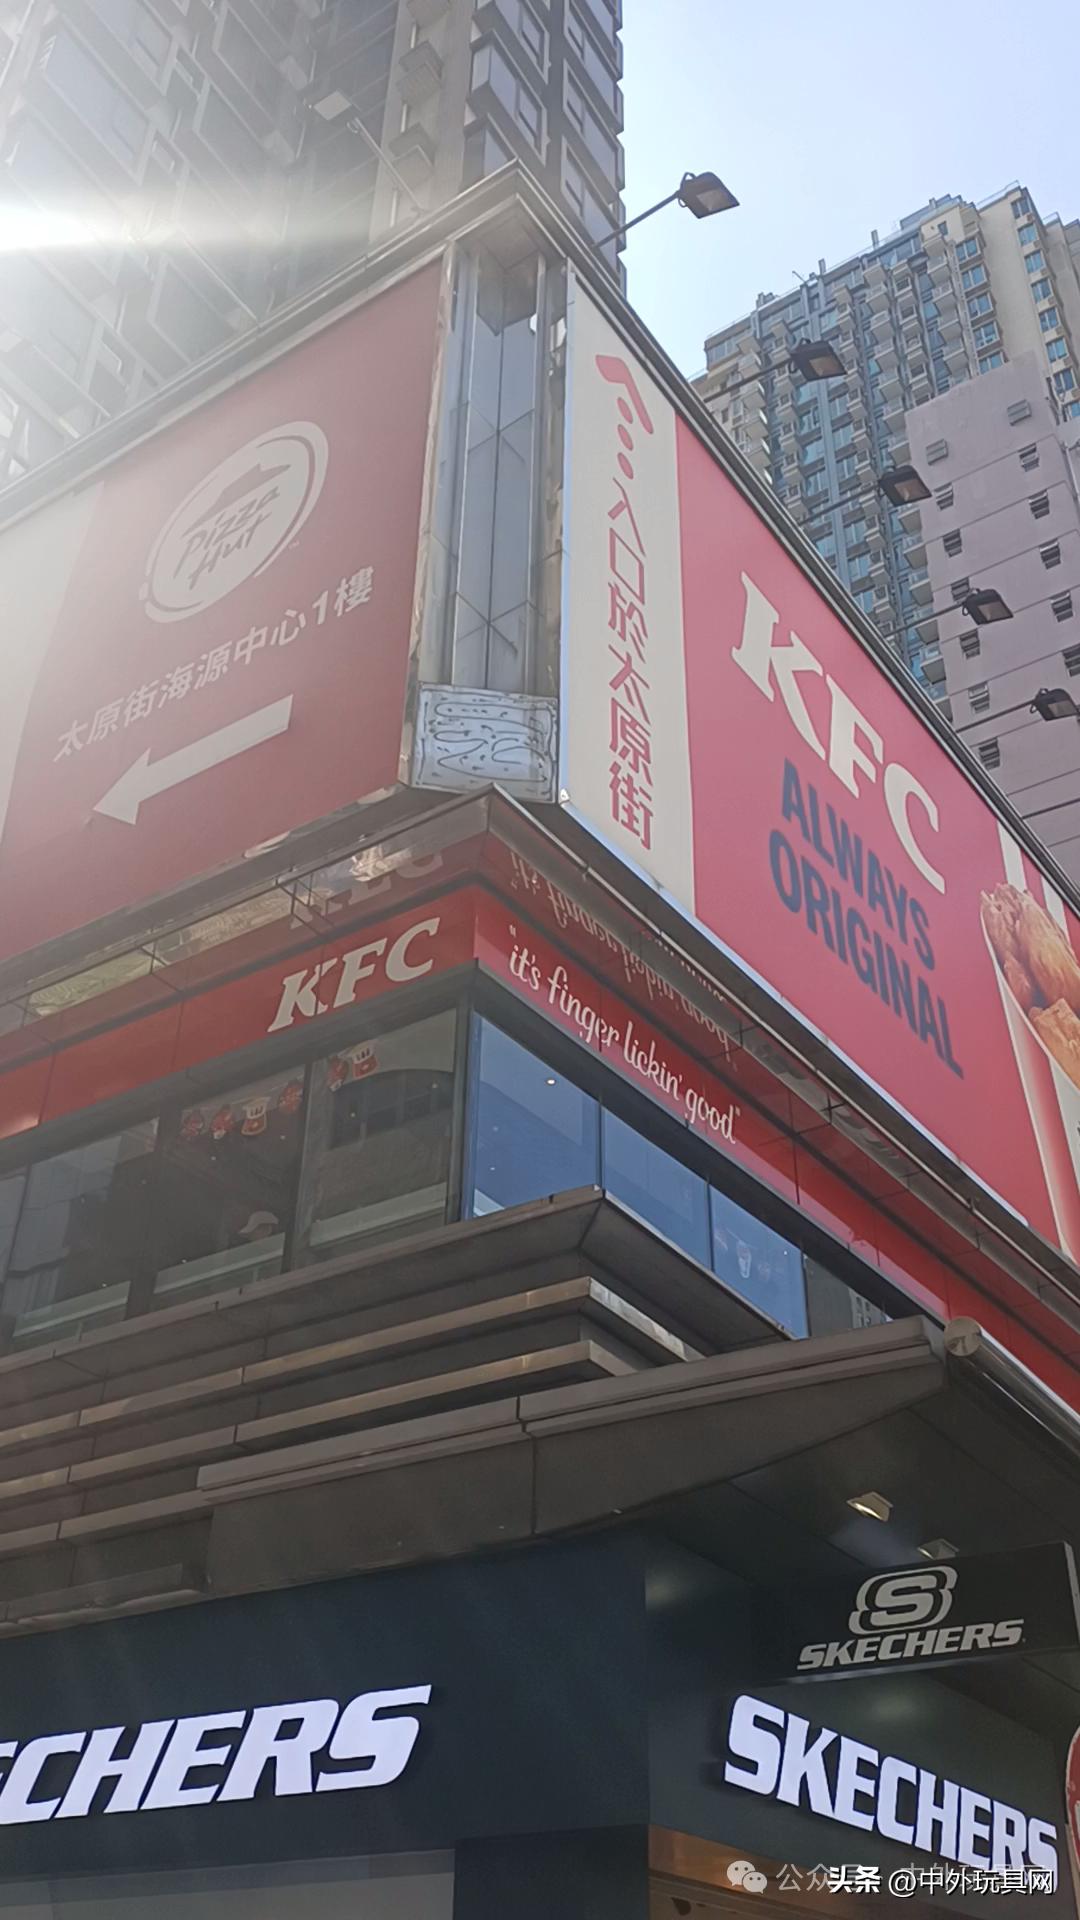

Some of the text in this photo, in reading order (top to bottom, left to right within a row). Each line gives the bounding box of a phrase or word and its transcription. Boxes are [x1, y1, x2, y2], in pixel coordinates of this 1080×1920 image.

[173, 486, 280, 579] Pizza
[187, 511, 272, 590] Hut
[607, 477, 654, 850] 入口於太原街
[731, 571, 945, 894] KFC
[782, 757, 935, 971] ALWAYS
[267, 917, 440, 1033] KFC
[769, 829, 964, 1080] ORIGINAL
[546, 965, 620, 1047] finger
[623, 1020, 683, 1101] lickin'
[797, 1618, 1025, 1671] SKECHERS
[0, 1684, 432, 1825] CHERS
[724, 1694, 1059, 1893] SKECHERS
